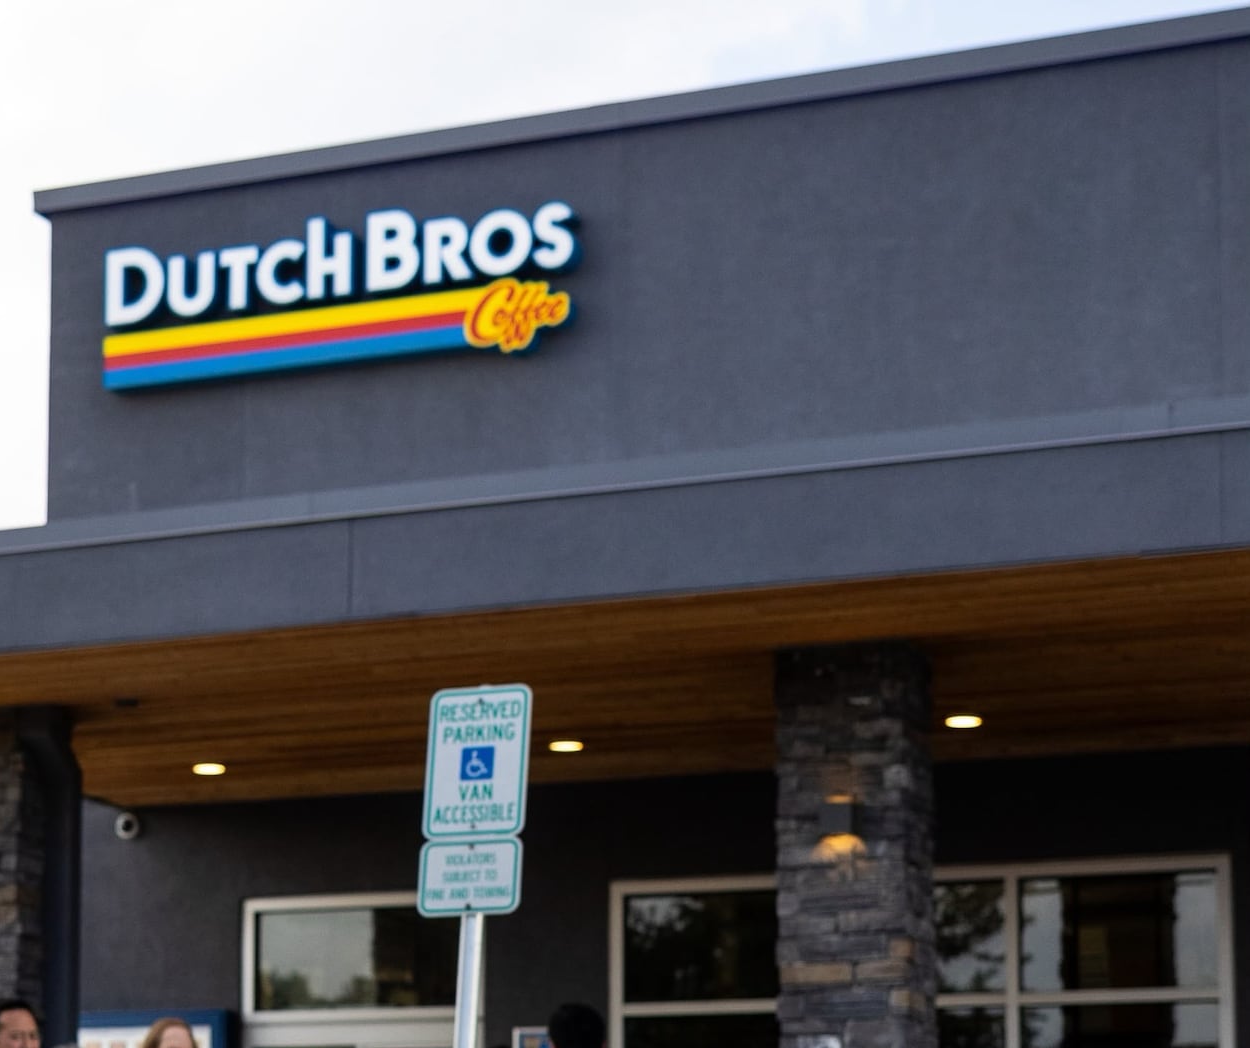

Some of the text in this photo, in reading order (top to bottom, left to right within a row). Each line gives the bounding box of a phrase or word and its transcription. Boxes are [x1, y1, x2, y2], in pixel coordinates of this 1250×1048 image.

[365, 202, 575, 293] BROS
[468, 281, 566, 348] Coffee
[439, 700, 522, 723] RESERVED
[442, 723, 516, 744] PARKING
[458, 783, 493, 801] VAN
[432, 802, 515, 825] ACCESSIBLE
